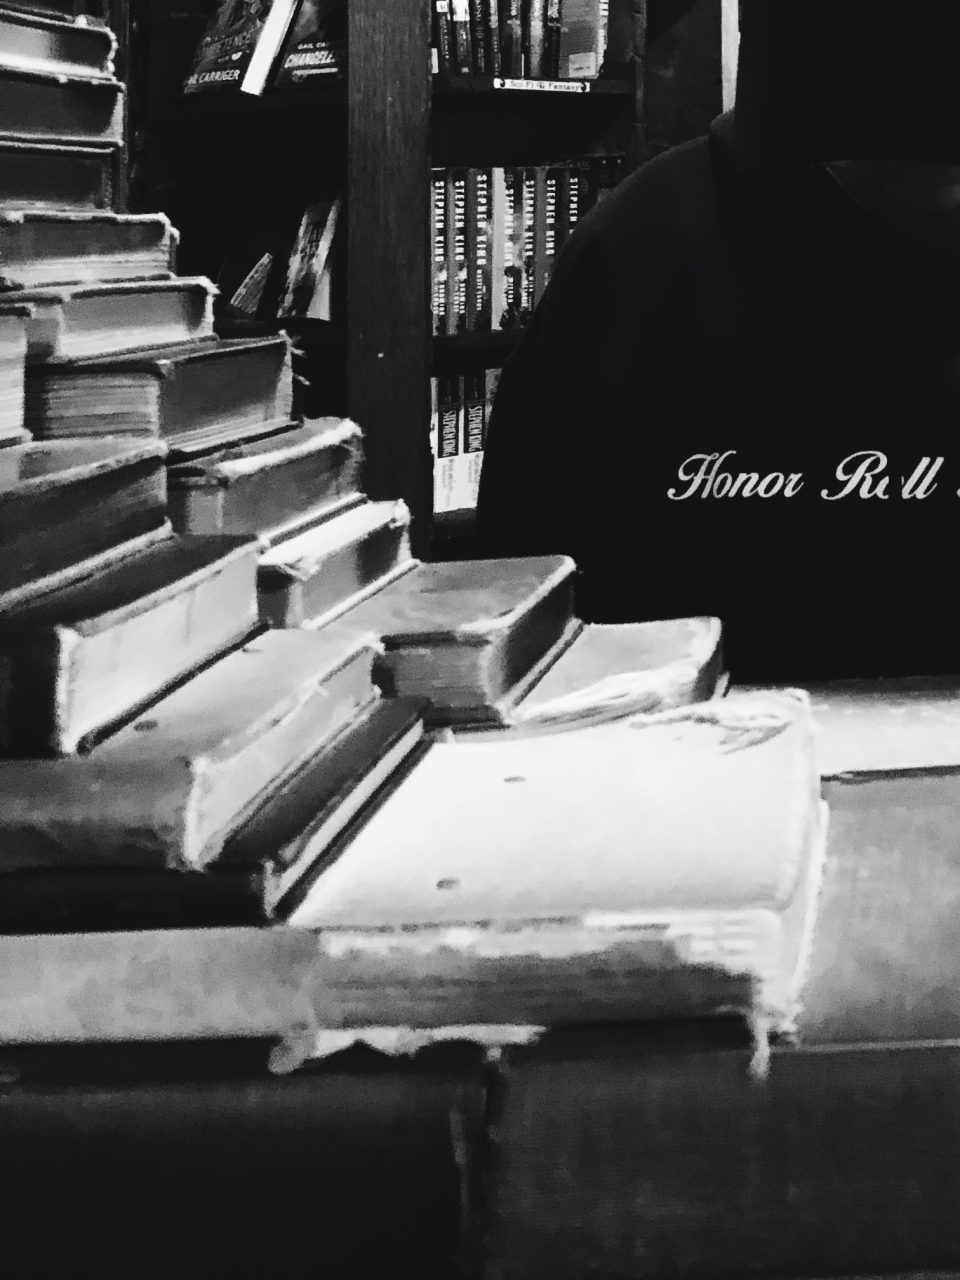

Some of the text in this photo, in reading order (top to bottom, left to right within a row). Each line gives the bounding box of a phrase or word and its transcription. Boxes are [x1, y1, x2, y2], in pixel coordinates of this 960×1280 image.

[199, 69, 240, 83] CARRIGER
[435, 181, 445, 262] STEPHEN KING
[455, 180, 465, 261] STEPHEN KING
[476, 174, 487, 266] STEPHEN KING
[524, 180, 535, 257] STEPHEN KING
[545, 179, 556, 256] STEPHEN KING
[569, 177, 579, 222] STEPHEN
[442, 410, 457, 439] STEPHEN
[468, 405, 483, 434] STEPHEN
[468, 434, 483, 452] KING
[442, 439, 457, 457] KING
[667, 450, 804, 500] Honor
